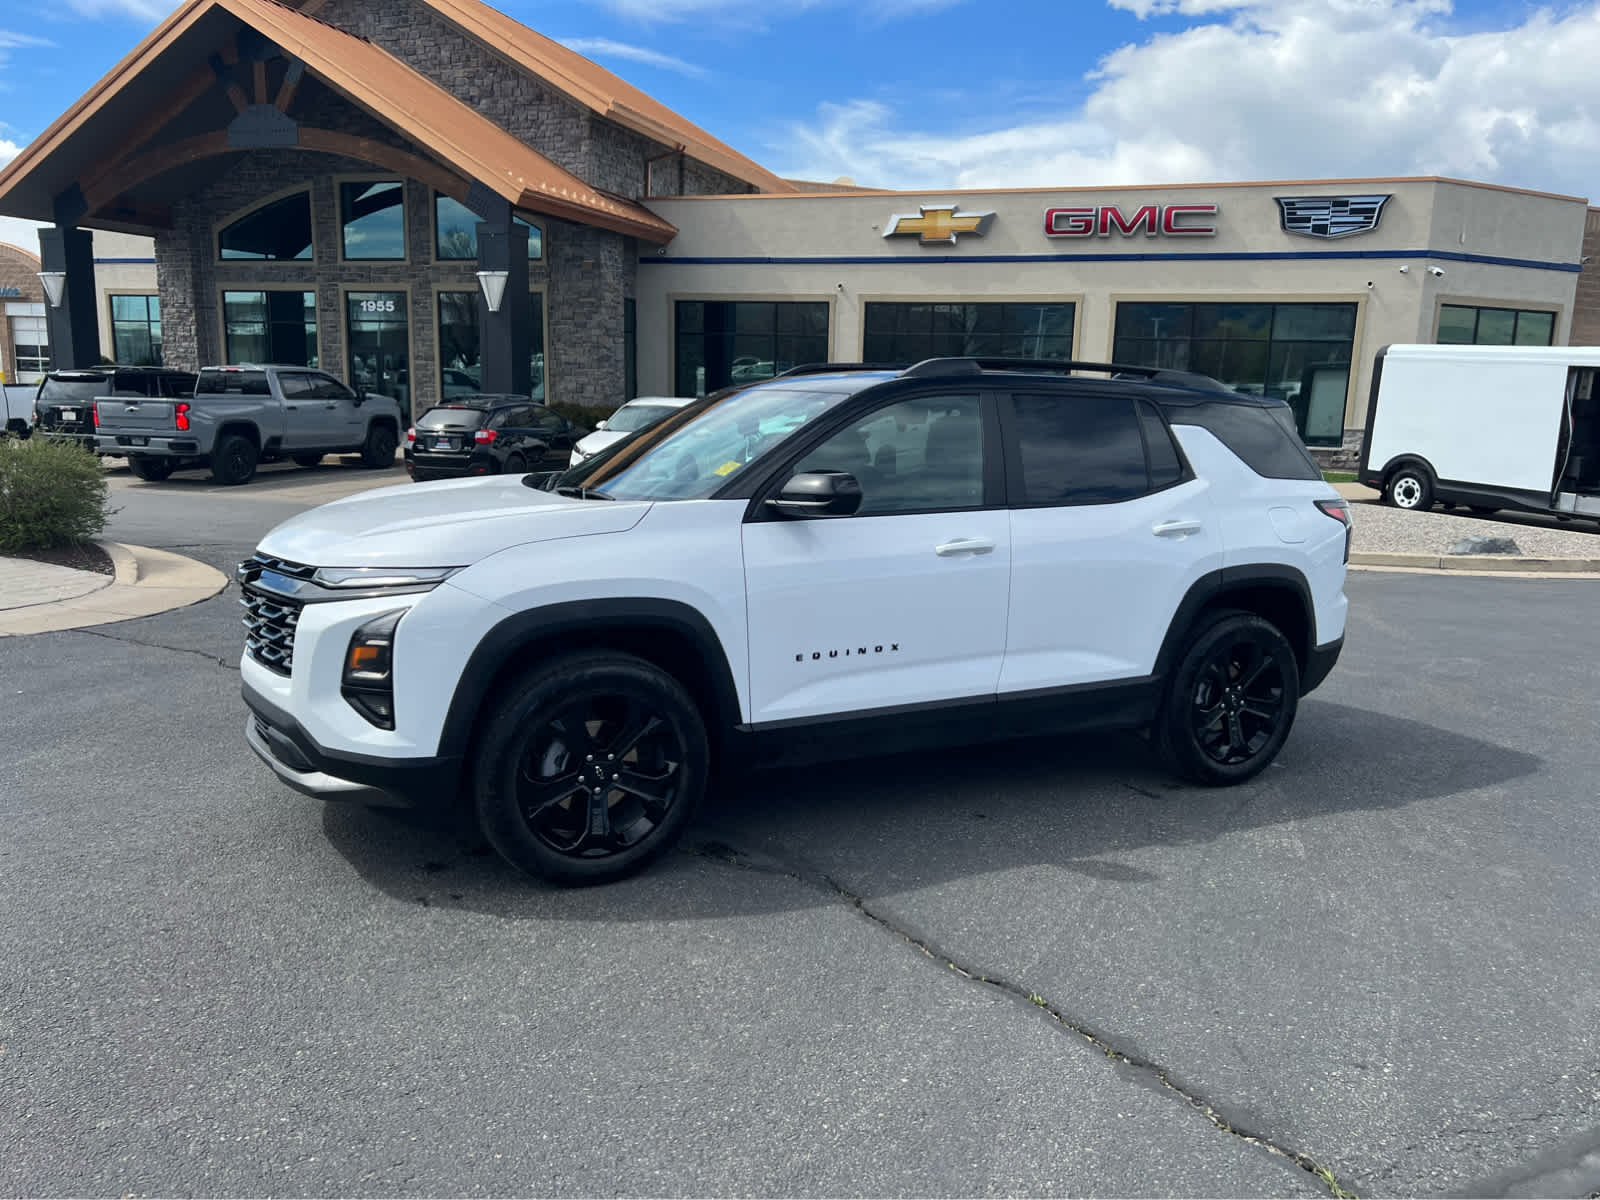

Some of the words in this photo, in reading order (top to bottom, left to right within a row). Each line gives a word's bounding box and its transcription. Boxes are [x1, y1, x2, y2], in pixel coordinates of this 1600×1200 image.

[1044, 204, 1218, 238] GMC
[360, 300, 395, 312] 1955
[795, 643, 900, 662] EQUINOX
